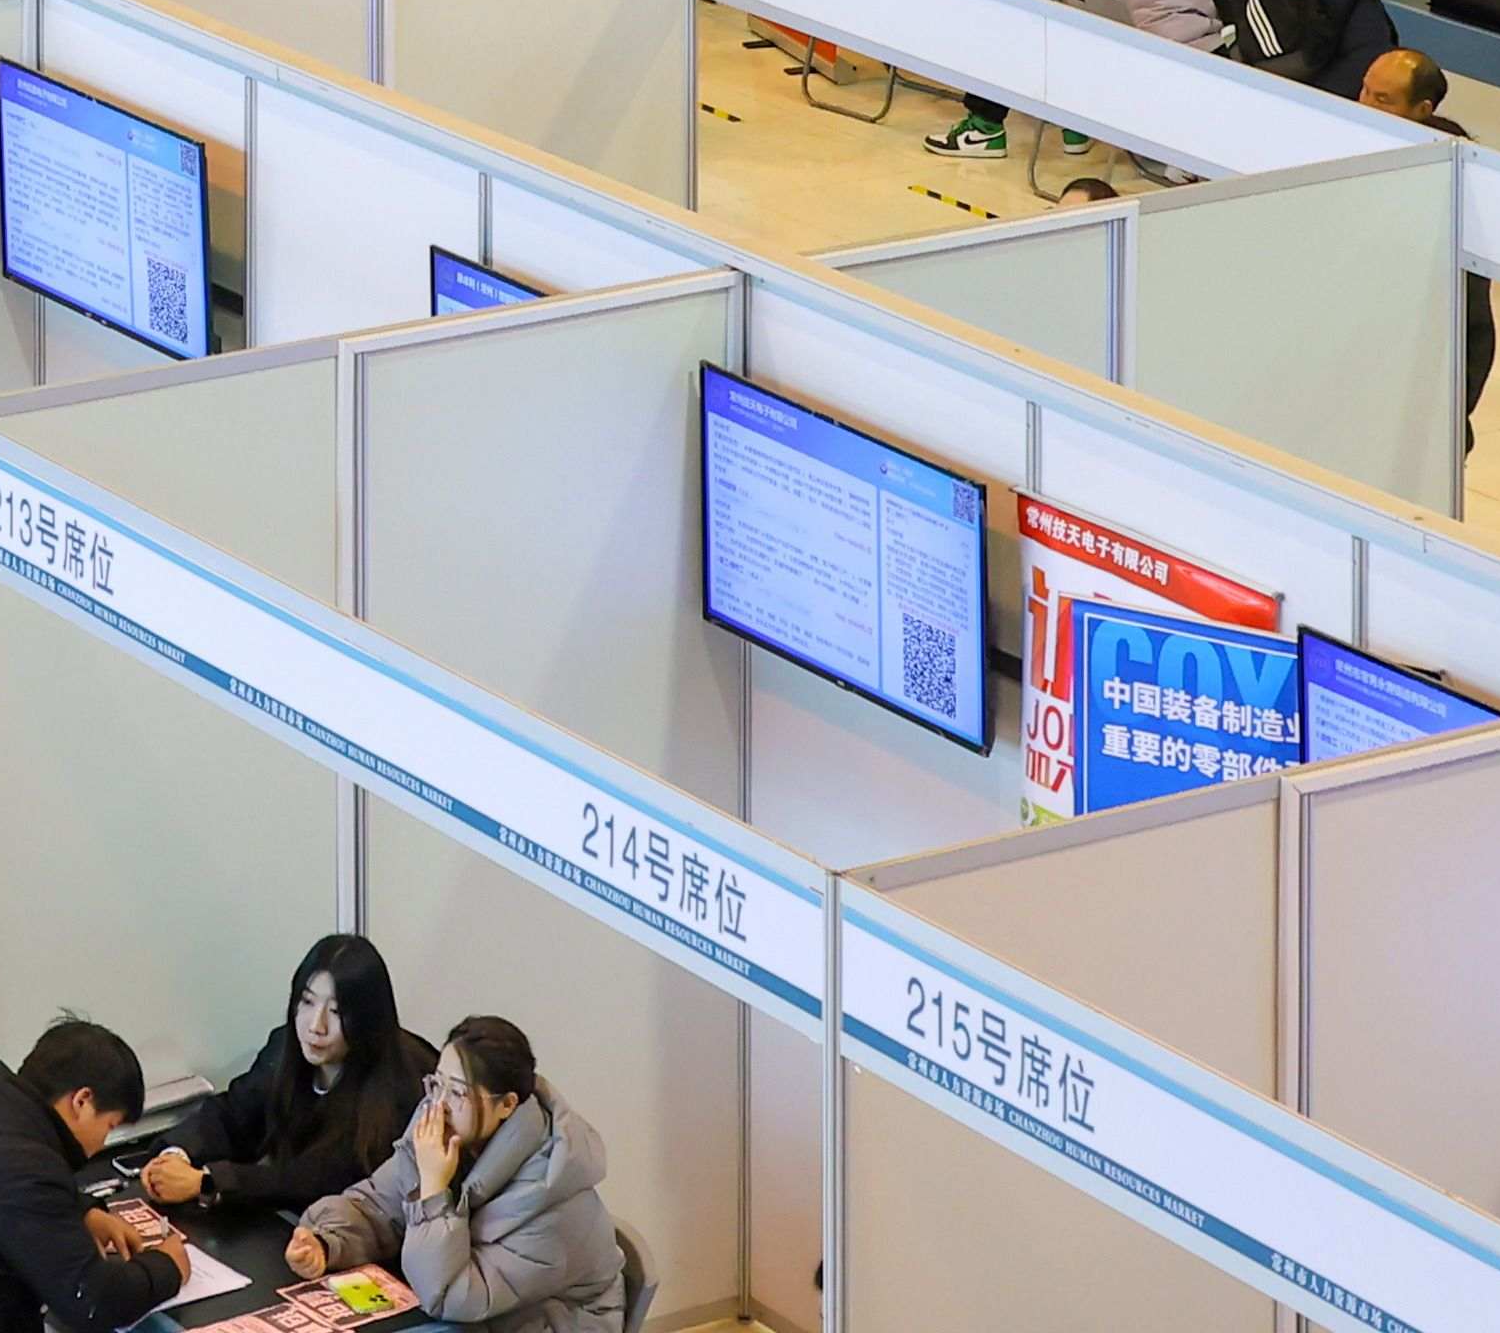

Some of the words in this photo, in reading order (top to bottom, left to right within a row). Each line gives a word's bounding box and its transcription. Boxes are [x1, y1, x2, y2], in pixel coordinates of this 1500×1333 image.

[1026, 505, 1169, 586] 常州技天电子有限公司
[583, 802, 748, 943] 214号席位
[632, 900, 664, 929] HUMAN
[665, 915, 714, 957] RESOURCES
[715, 942, 752, 976] MARKET
[907, 976, 1096, 1135] 215号席位
[907, 1051, 1005, 1121] 常州市人力资源市场
[1065, 1137, 1102, 1171] HUMAN
[1104, 1158, 1162, 1206] RESOURCES
[1163, 1190, 1206, 1229] MARKET
